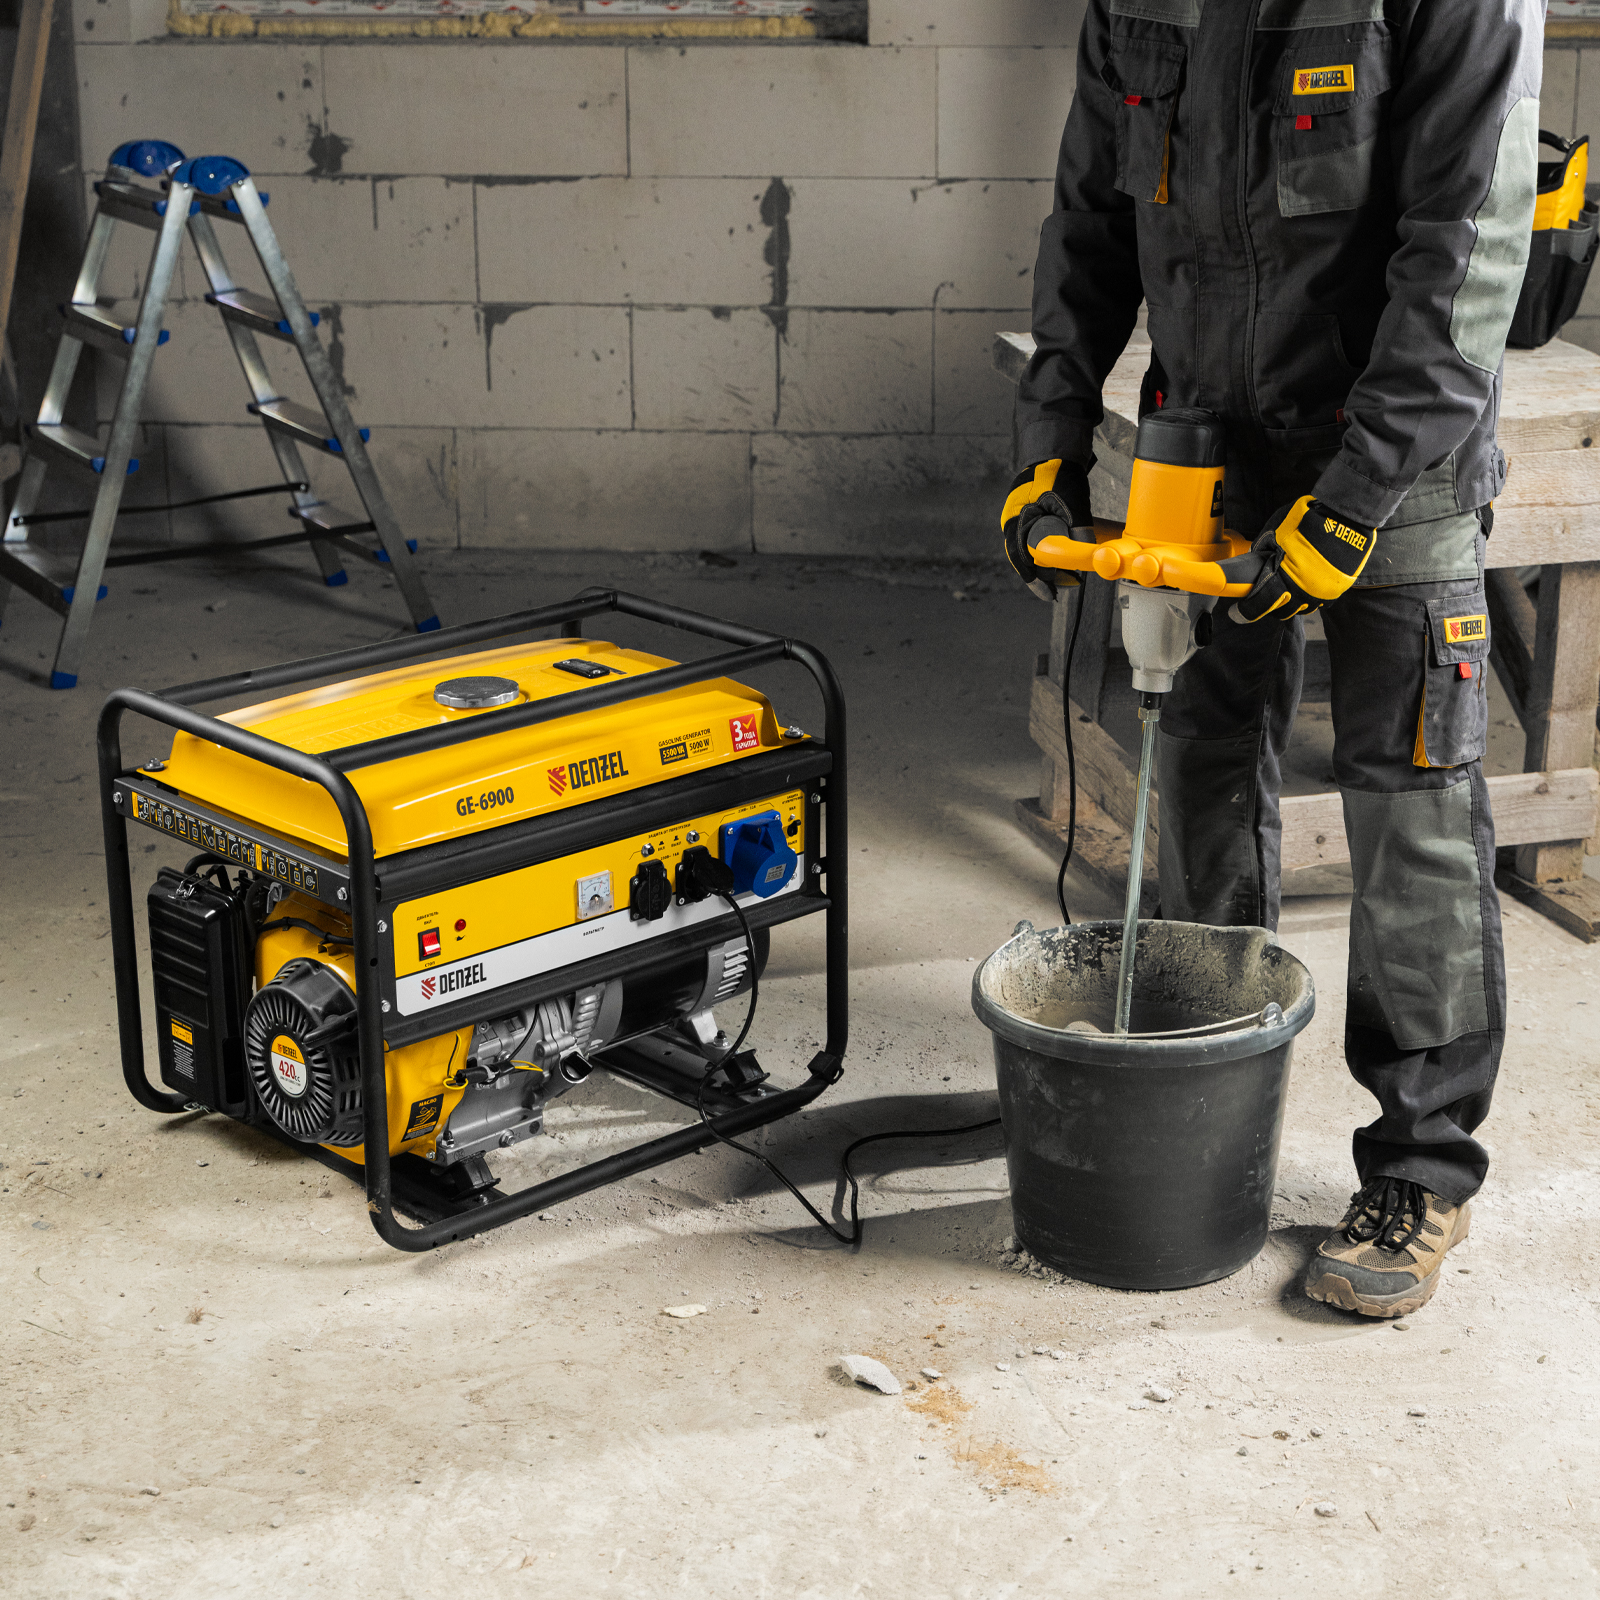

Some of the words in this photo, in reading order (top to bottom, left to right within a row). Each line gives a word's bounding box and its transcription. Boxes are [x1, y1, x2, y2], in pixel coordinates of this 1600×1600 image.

[1310, 70, 1347, 88] DENZEL
[1335, 524, 1367, 551] DENZEL
[1460, 620, 1483, 637] DENZEL
[658, 736, 682, 747] GASOLINE
[682, 728, 710, 741] GENERATOR
[733, 720, 743, 742] 3
[744, 731, 755, 739] ГОДА
[662, 748, 677, 758] 5500
[689, 740, 702, 750] 5000
[703, 738, 710, 746] W
[736, 740, 757, 750] ГАРАНТИИ
[568, 750, 629, 790] DENZEL
[456, 786, 514, 816] GE-6900
[440, 962, 487, 995] DENZEL
[282, 1045, 298, 1059] DENZEL
